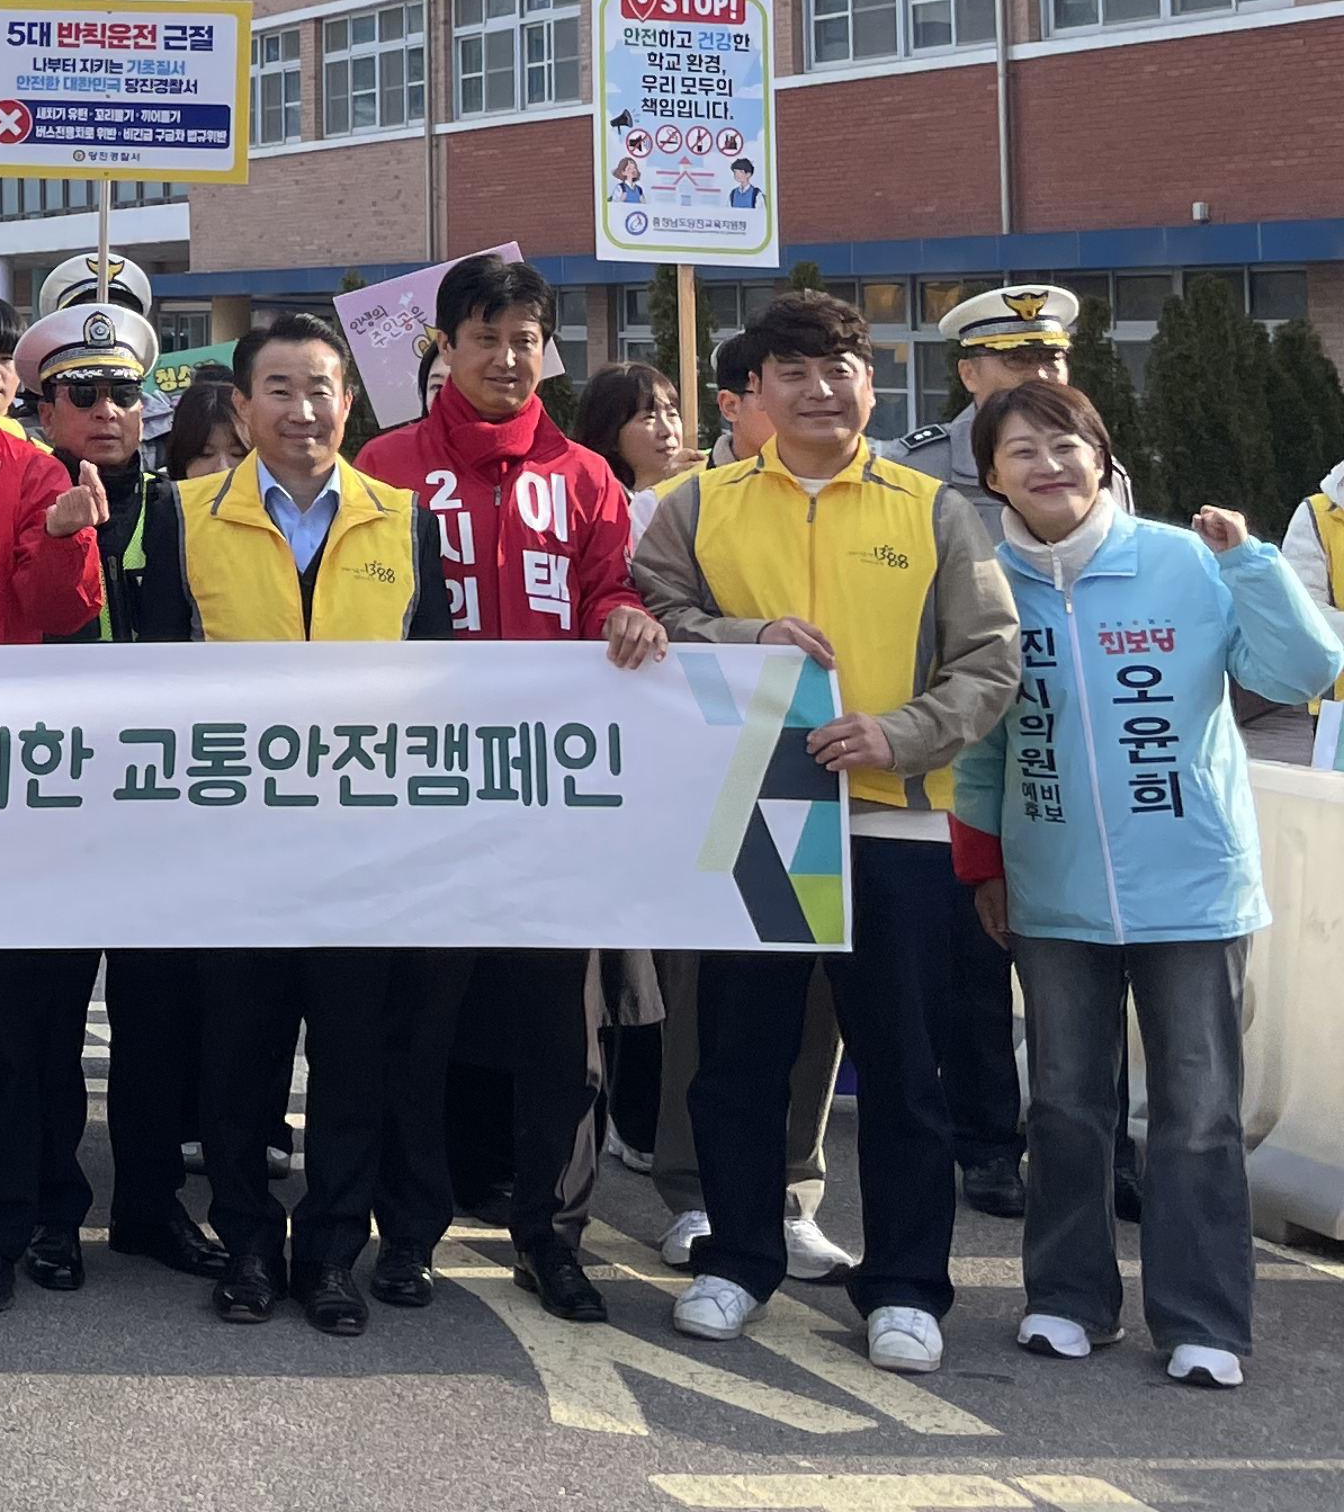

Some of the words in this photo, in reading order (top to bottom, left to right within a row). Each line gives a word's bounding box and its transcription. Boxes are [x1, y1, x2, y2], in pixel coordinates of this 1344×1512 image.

[6, 21, 52, 48] 5대
[56, 22, 158, 51] 반칙운전
[163, 24, 215, 52] 근절
[623, 27, 693, 50] 안전하고
[697, 32, 751, 53] 건강한
[32, 57, 77, 74] 나부터
[79, 58, 124, 75] 지키는
[126, 59, 186, 76] 기초질서
[647, 52, 682, 72] 학교
[687, 54, 727, 76] 환경,
[16, 75, 61, 92] 안전한
[63, 76, 122, 93] 대한민국
[124, 77, 199, 95] 당진경찰서
[641, 75, 676, 95] 우리
[680, 76, 733, 98] 모두의
[35, 106, 67, 122] 새치기
[67, 107, 89, 121] 유턴
[640, 97, 735, 121] 책임입니다.
[35, 125, 95, 140] 버스전용차로
[96, 126, 117, 141] 위반
[155, 128, 185, 143] 구급차
[186, 129, 227, 144] 법규위반
[88, 151, 141, 162] 당진경찰서
[349, 305, 389, 335] 인생의
[372, 306, 429, 346] 주인공은
[425, 469, 463, 511] 2
[873, 544, 909, 570] 1388
[364, 559, 396, 584] 1388
[1097, 627, 1176, 656] 진보당
[1112, 663, 1185, 819] 오윤희
[112, 721, 624, 809] 교통안전캠페인
